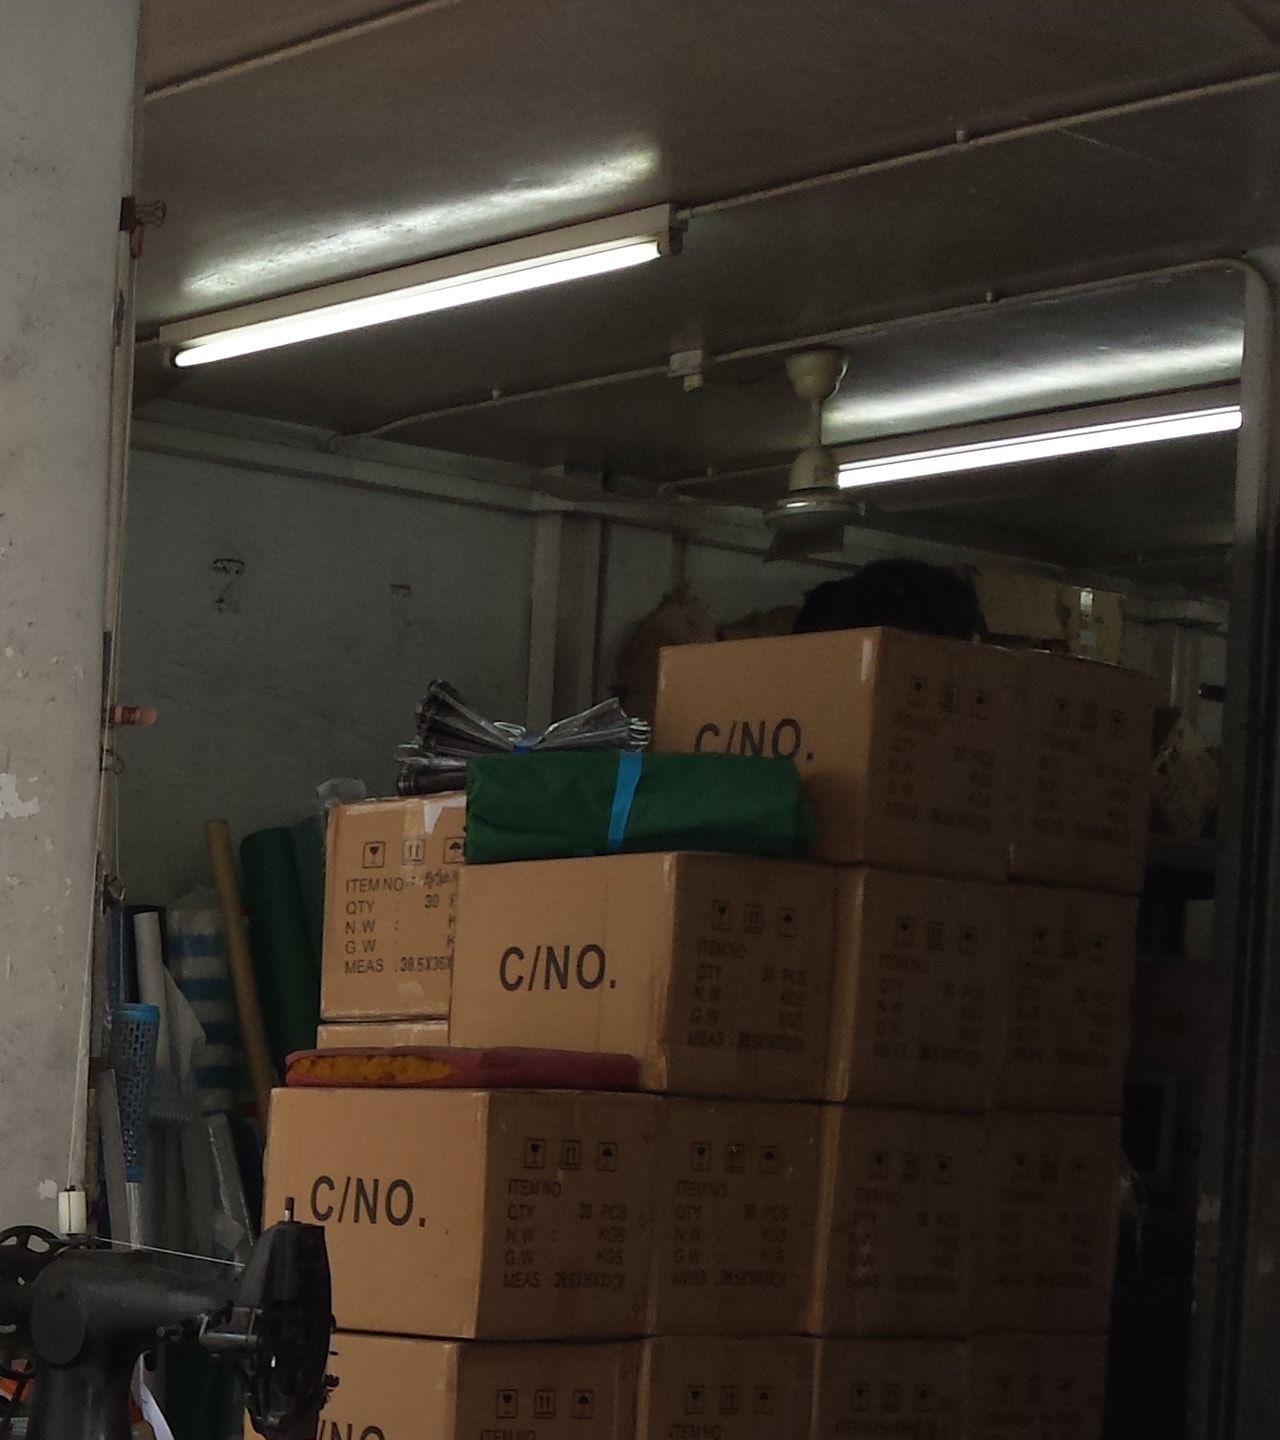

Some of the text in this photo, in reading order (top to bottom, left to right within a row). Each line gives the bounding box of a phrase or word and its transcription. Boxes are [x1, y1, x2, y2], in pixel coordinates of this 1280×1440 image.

[345, 901, 375, 915] QTY
[344, 959, 384, 973] MEAS
[498, 943, 617, 991] C/NO.
[309, 1173, 426, 1228] C/NO.
